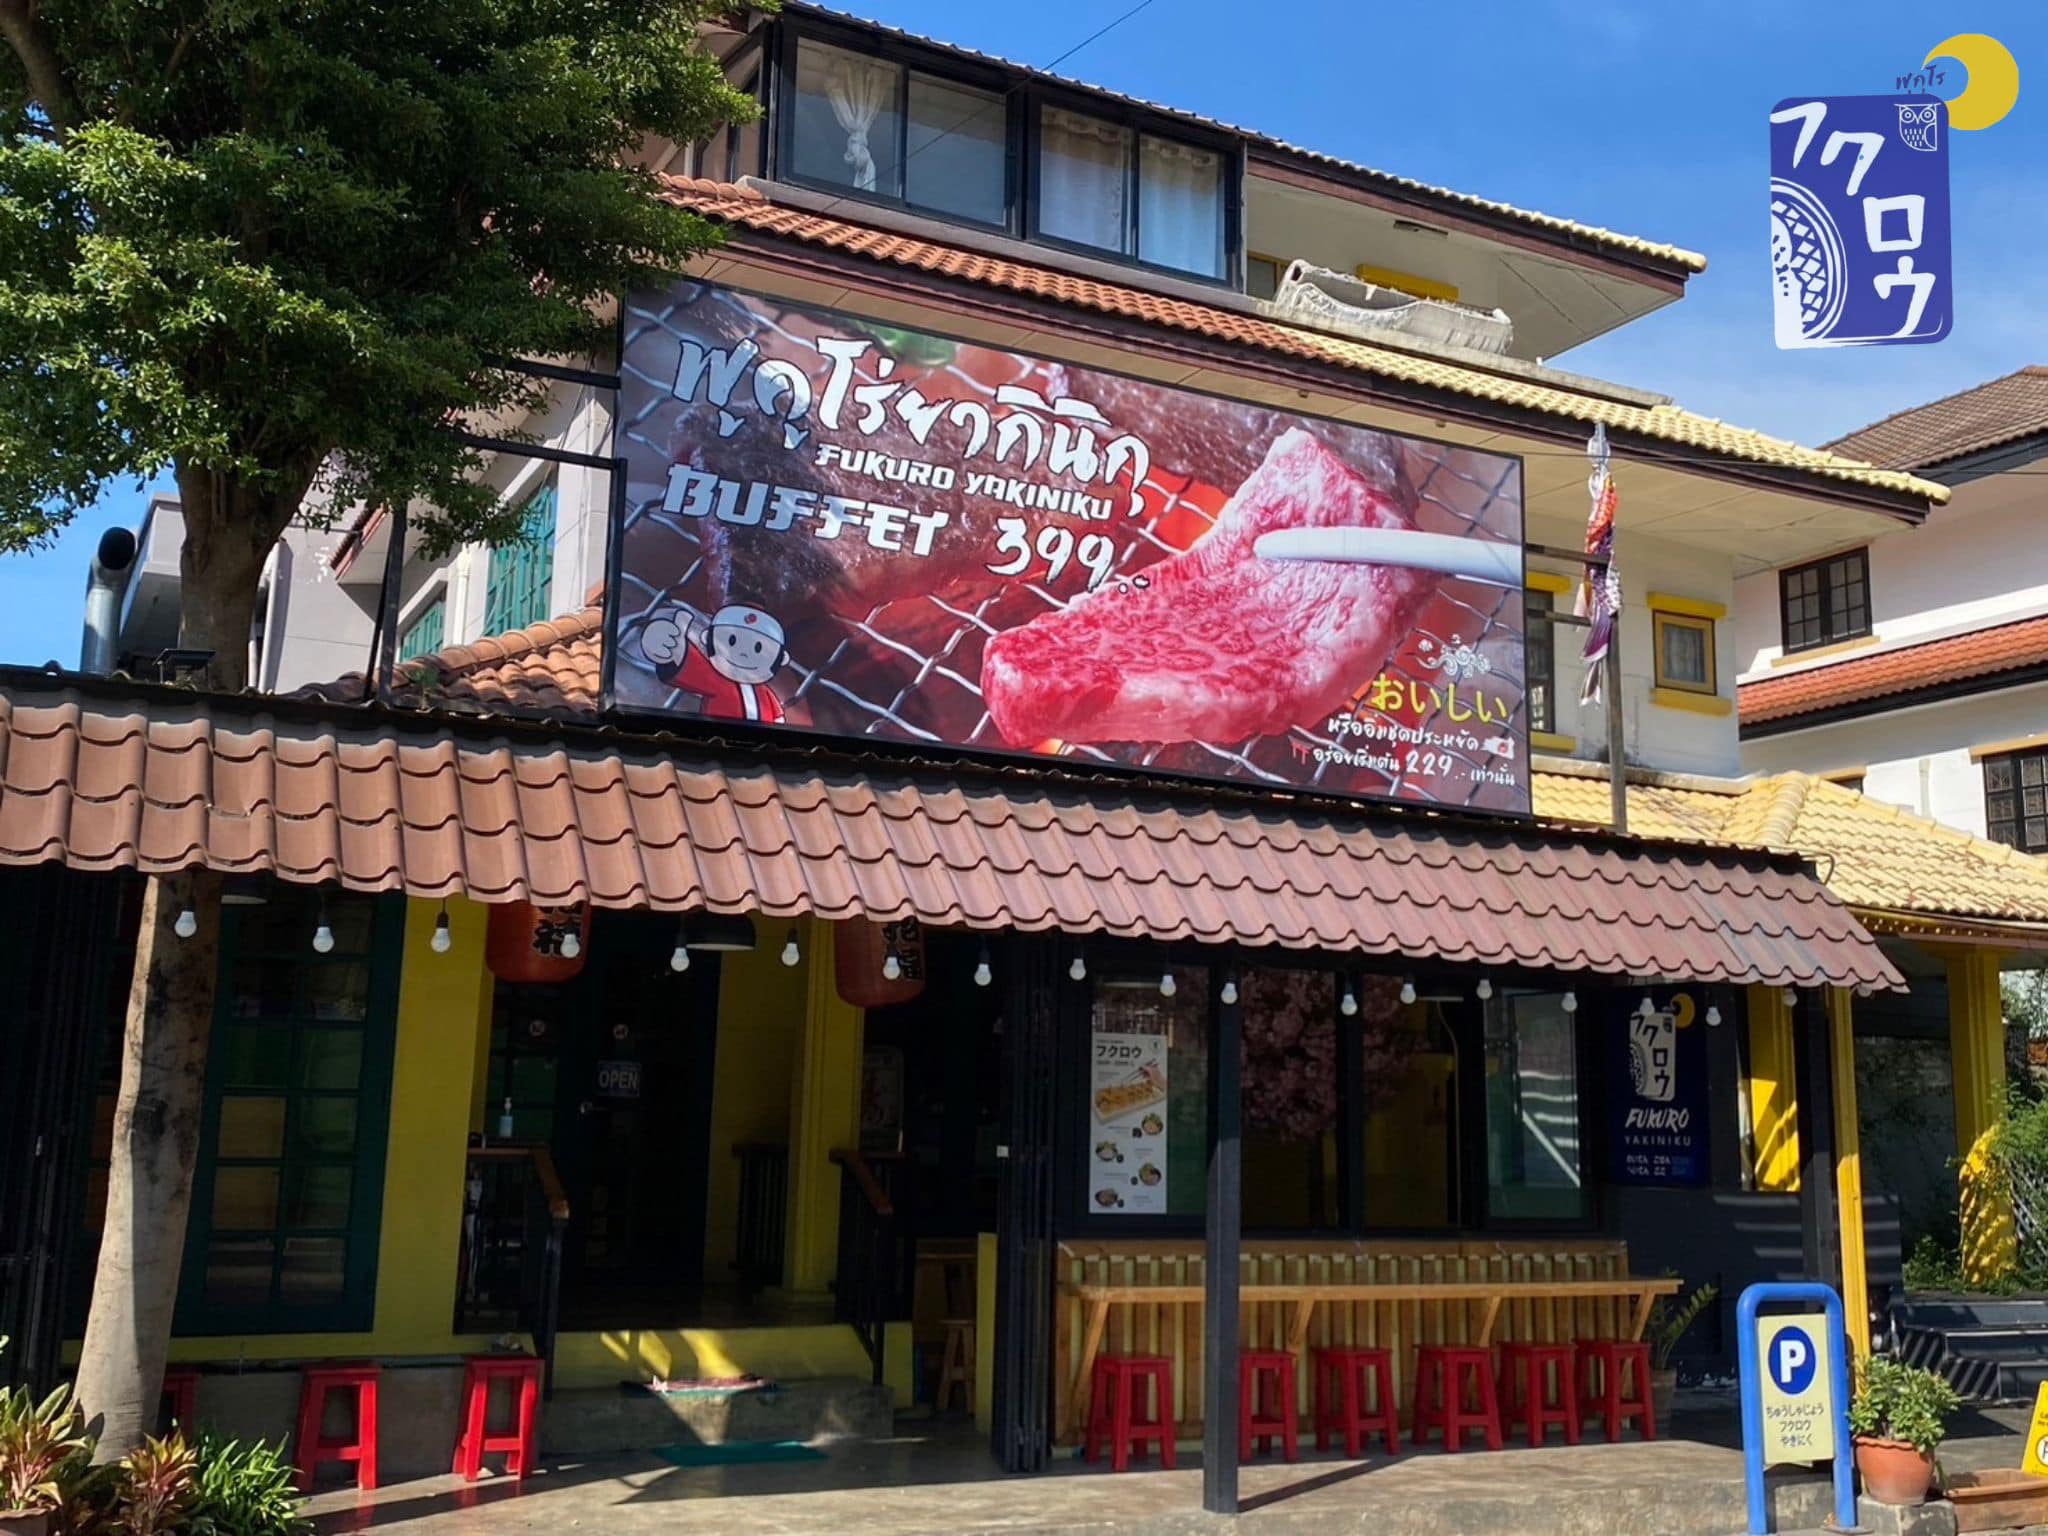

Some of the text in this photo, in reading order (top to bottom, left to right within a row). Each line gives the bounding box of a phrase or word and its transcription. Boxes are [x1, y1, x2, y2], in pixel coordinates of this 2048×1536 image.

[814, 443, 1114, 521] FUKURO YAKINIKU
[661, 461, 950, 556] BUFFET
[1371, 672, 1508, 723] おいしい
[1470, 765, 1515, 786] เท่านั้น
[1096, 1045, 1142, 1058] フクロウ
[598, 1071, 640, 1089] OPEN
[1624, 1106, 1690, 1134] FUKURO
[1624, 1135, 1692, 1147] YAKINIKU
[1779, 1339, 1807, 1384] P
